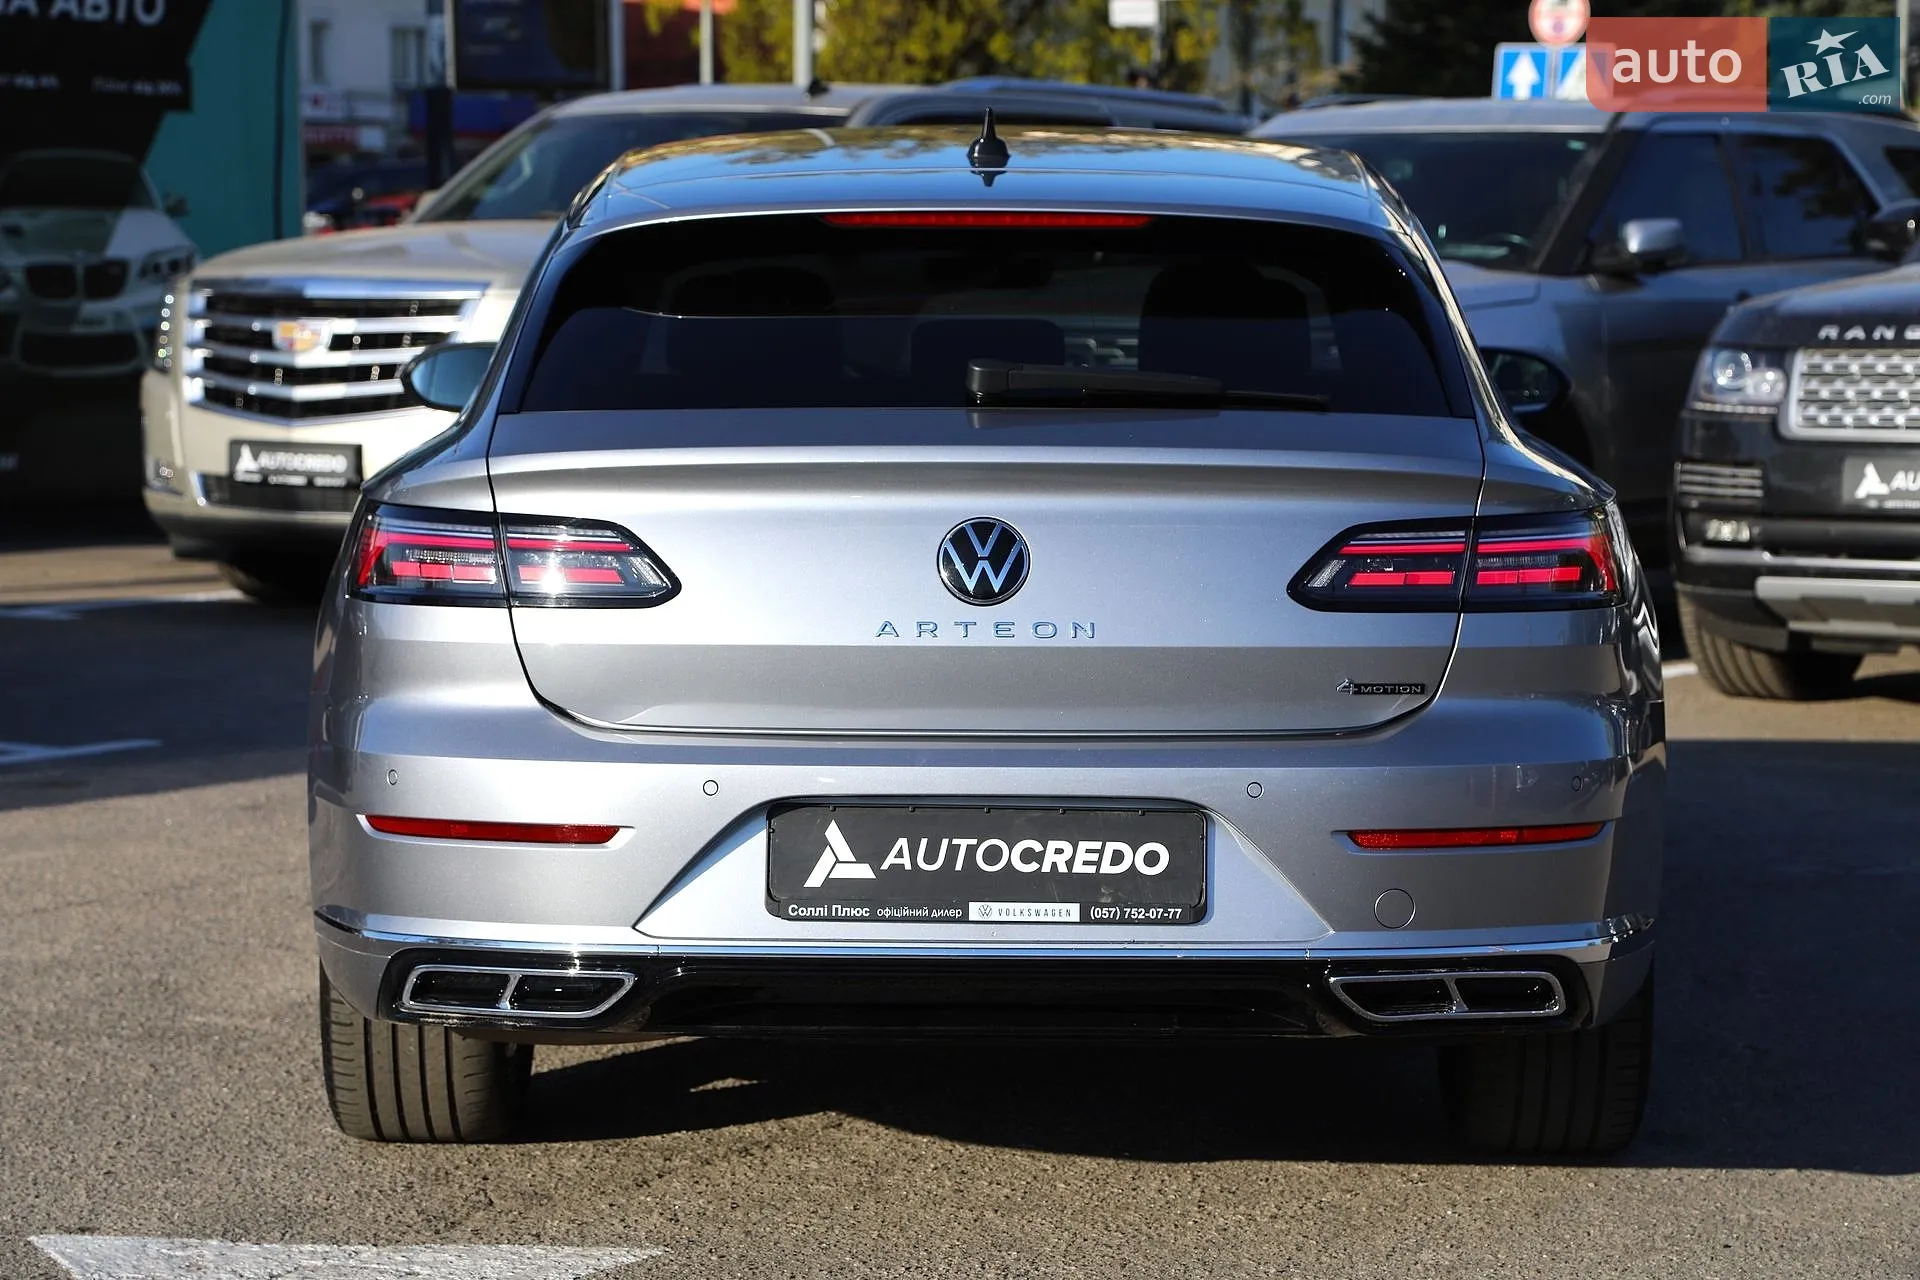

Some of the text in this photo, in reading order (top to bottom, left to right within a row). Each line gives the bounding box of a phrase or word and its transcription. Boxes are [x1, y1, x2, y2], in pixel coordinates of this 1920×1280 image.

[875, 620, 1096, 639] ARTEON
[880, 837, 1170, 876] AUTOCREDO
[788, 904, 962, 919] Соллі Плюс офіційний дилер
[997, 908, 1072, 918] VOLKSWAGEN
[1090, 906, 1183, 920] (057) 752-07-77
